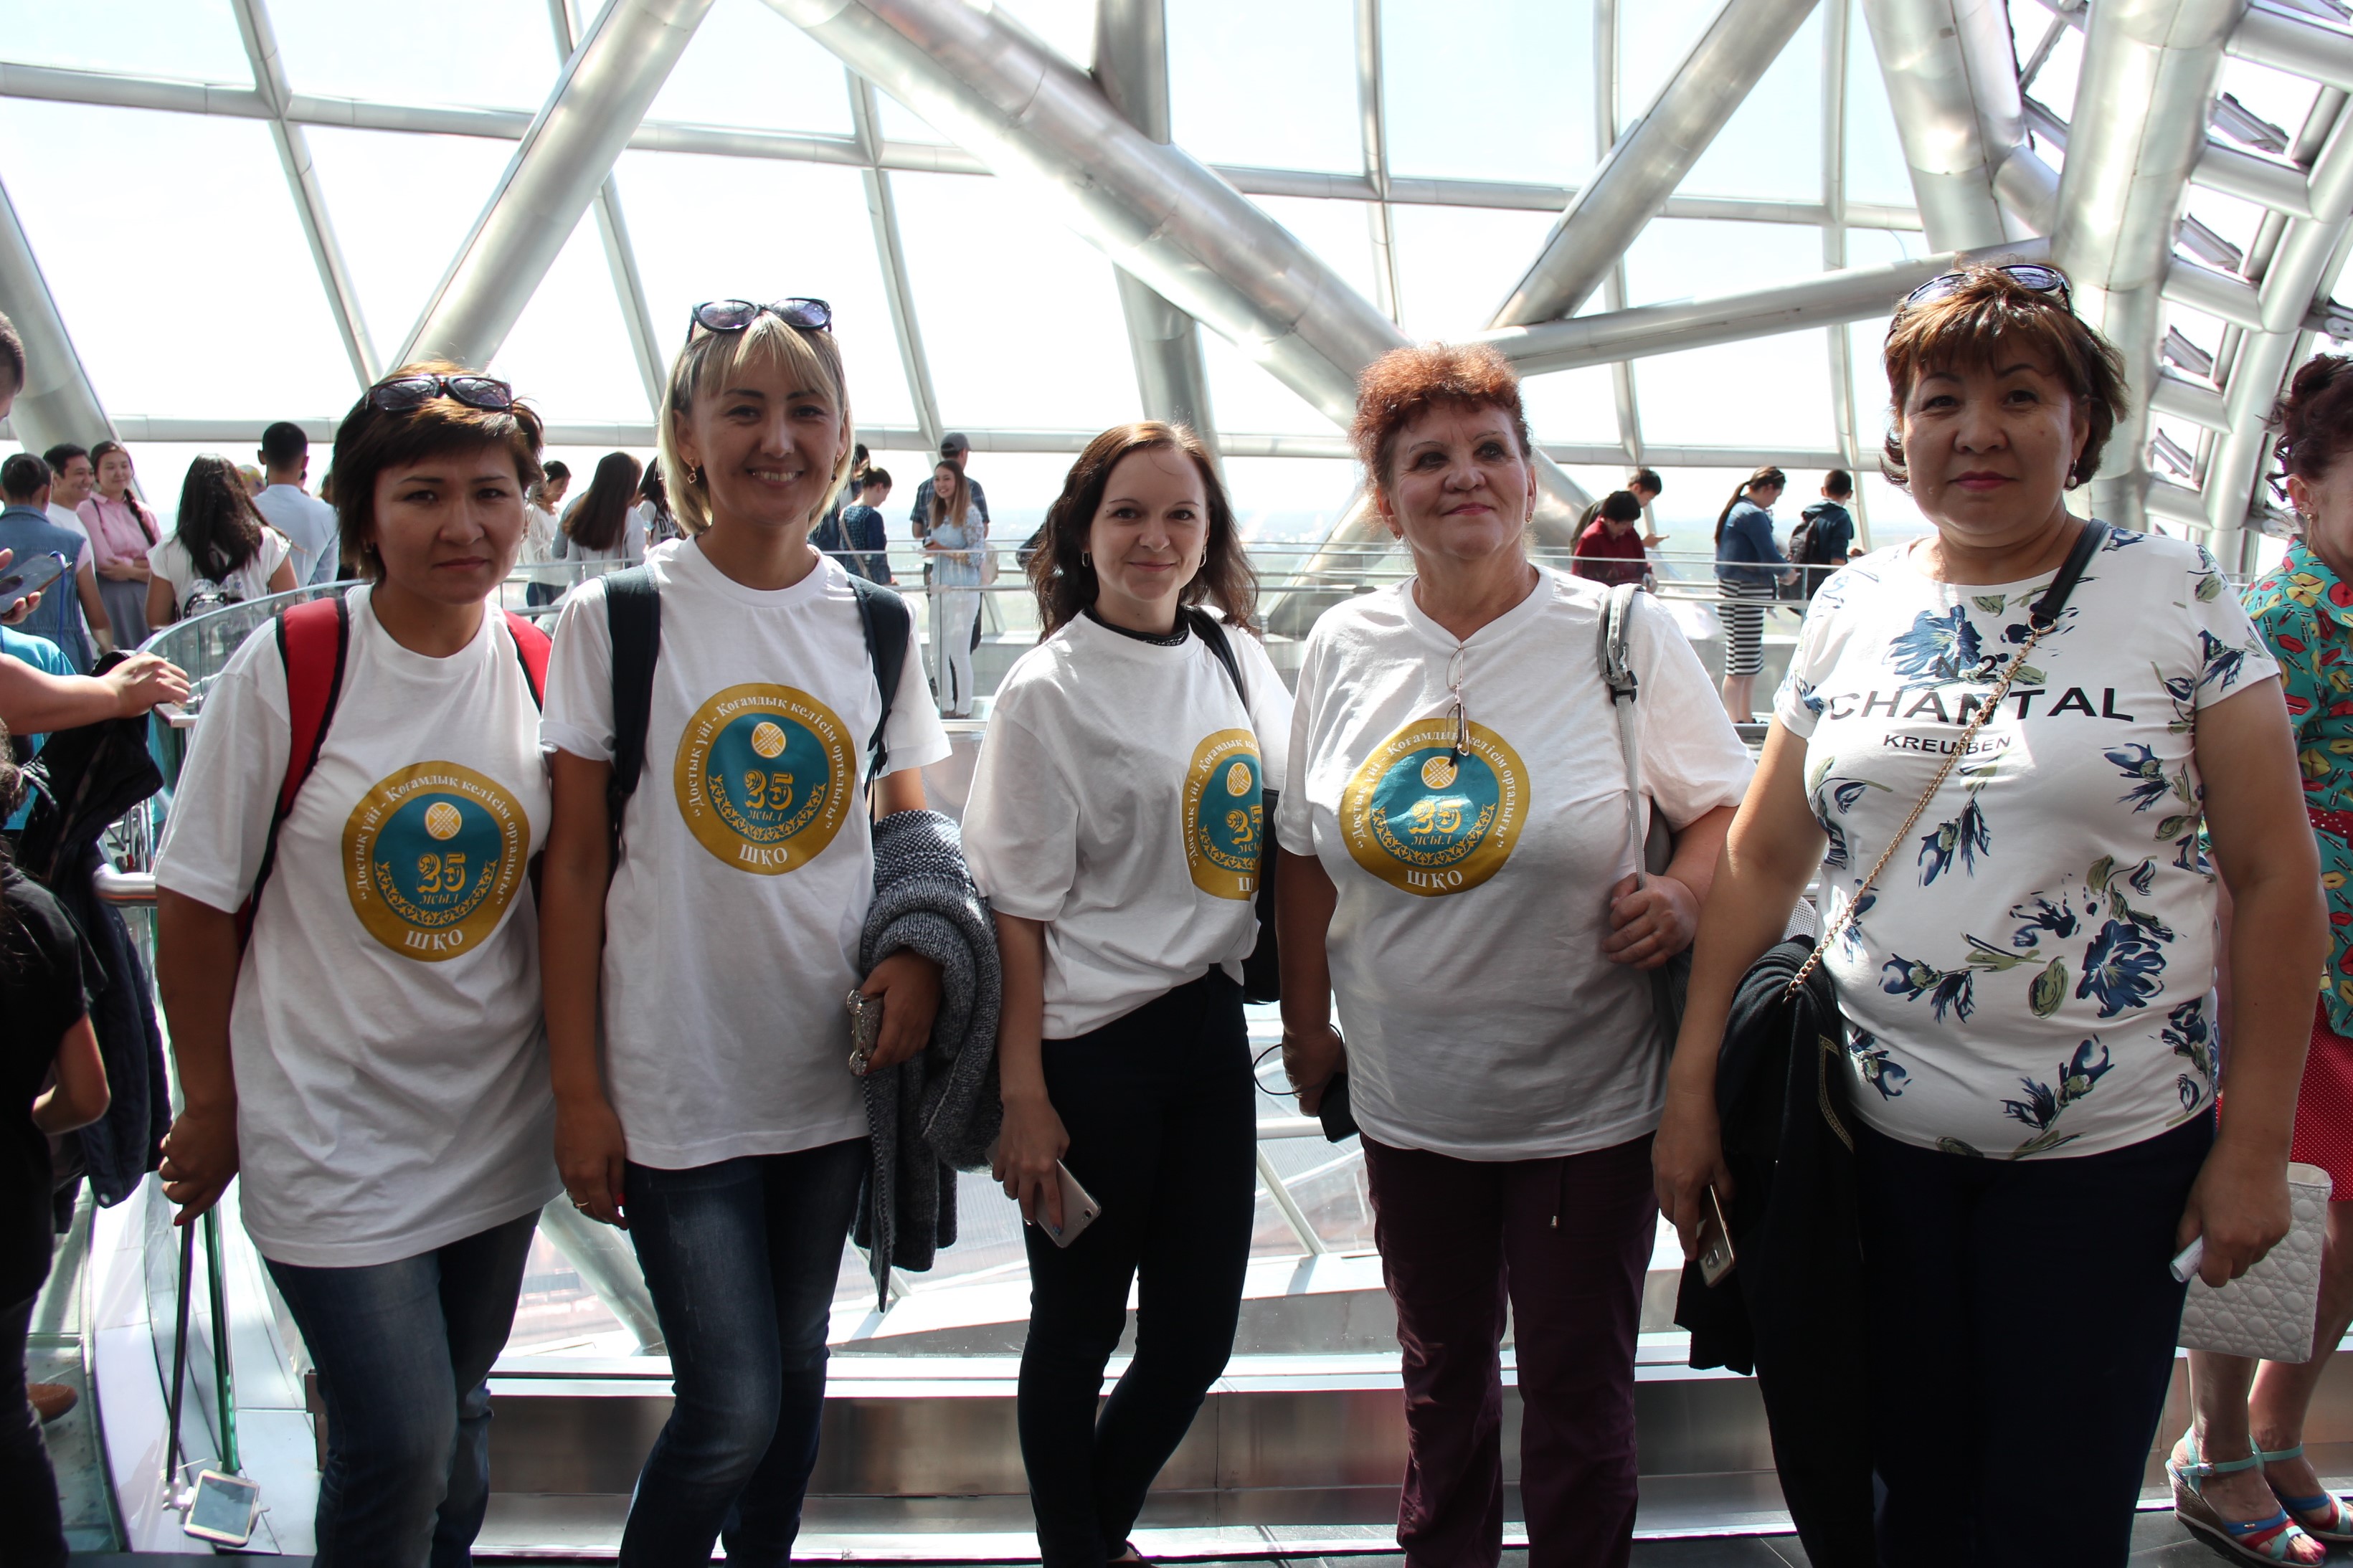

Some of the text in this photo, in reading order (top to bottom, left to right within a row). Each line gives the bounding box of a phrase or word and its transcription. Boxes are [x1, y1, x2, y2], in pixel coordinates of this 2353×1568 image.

[1829, 685, 2134, 726] CHANTAL
[743, 769, 795, 811] 25
[1407, 797, 1462, 836] 25
[416, 852, 466, 894] 25
[738, 843, 788, 870] ШҚО
[1406, 868, 1463, 891] ШҚО
[404, 928, 464, 953] ШҚО
